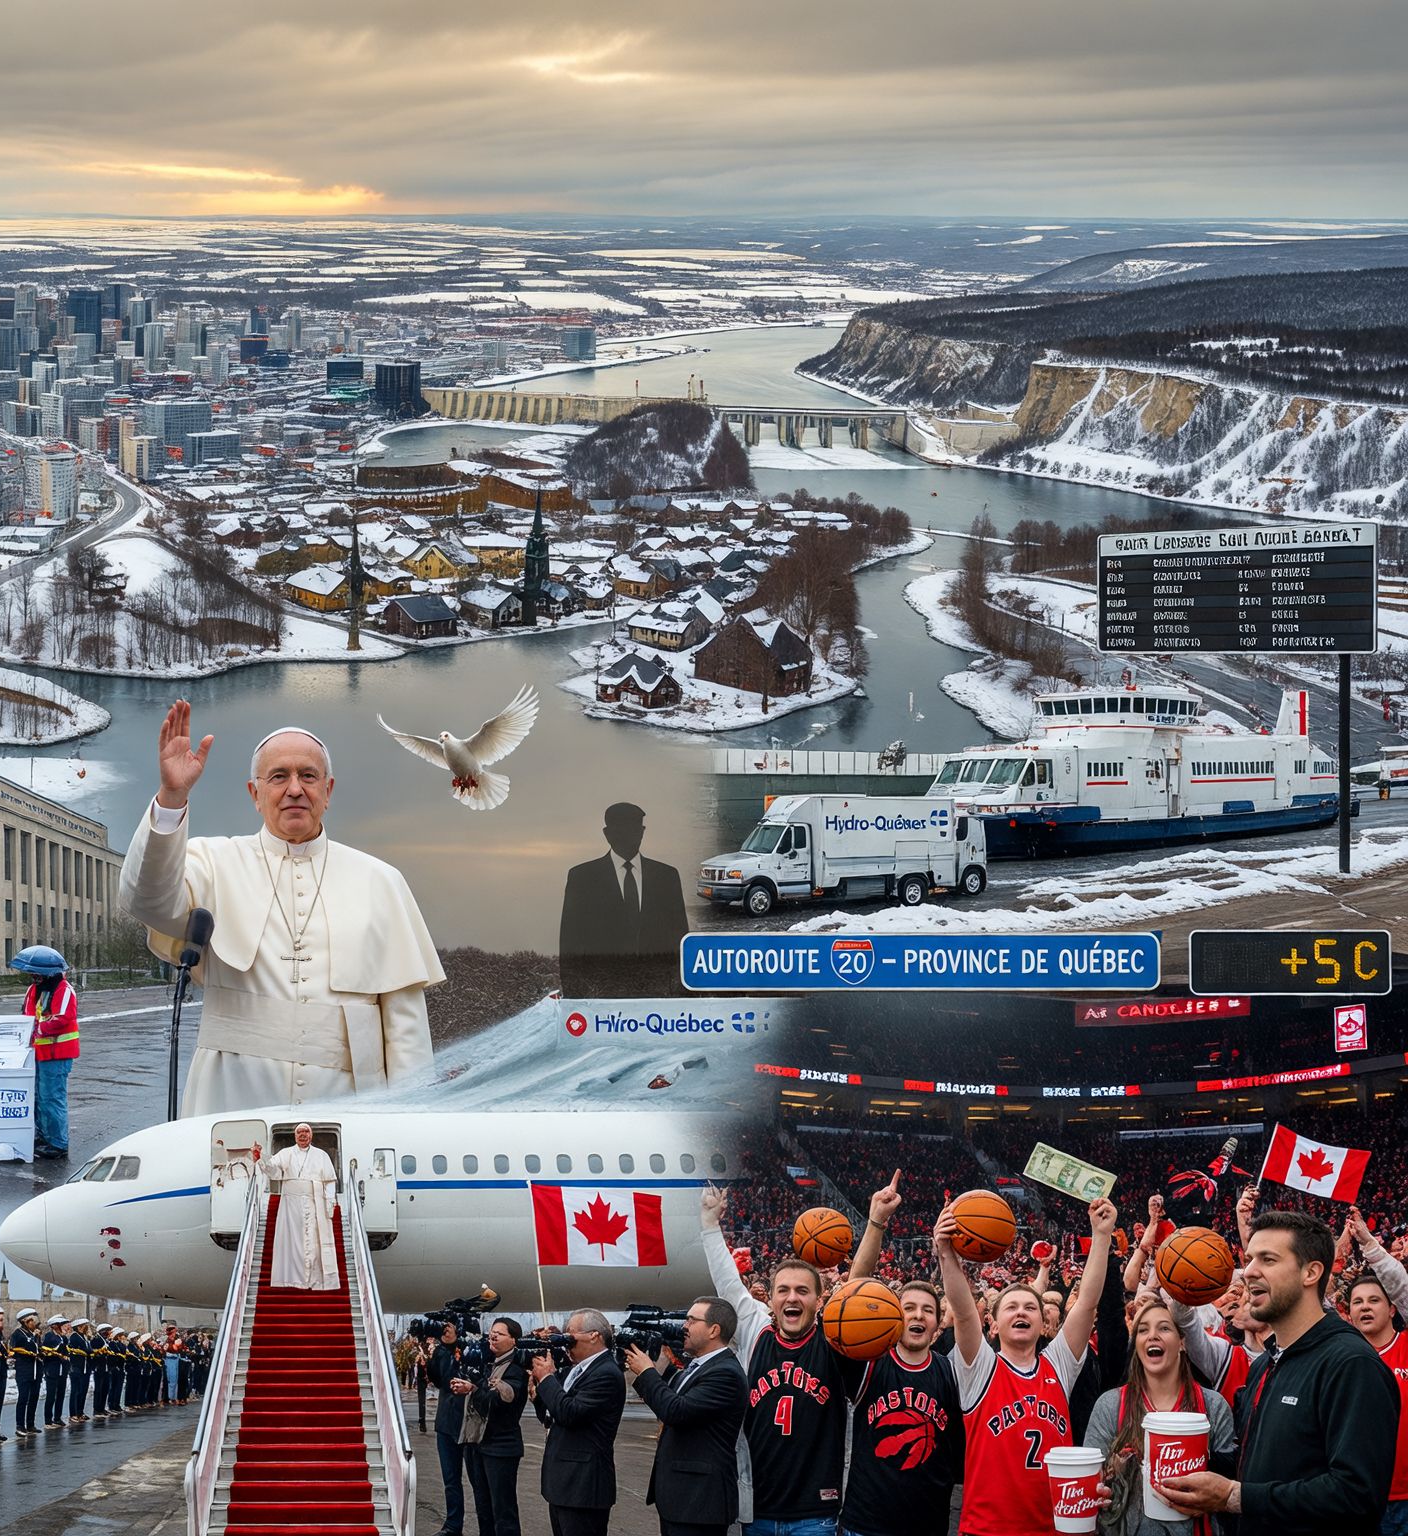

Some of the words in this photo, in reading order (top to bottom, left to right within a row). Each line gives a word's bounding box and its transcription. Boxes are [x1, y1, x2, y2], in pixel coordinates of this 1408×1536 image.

[692, 949, 820, 974] AUTOROUTE
[838, 952, 867, 974] 20
[904, 949, 1011, 974] PROVINCE
[1021, 949, 1049, 974] DE
[1058, 940, 1145, 976] QUÉBEC
[774, 1395, 795, 1436] 4
[1023, 1428, 1043, 1470] 2
